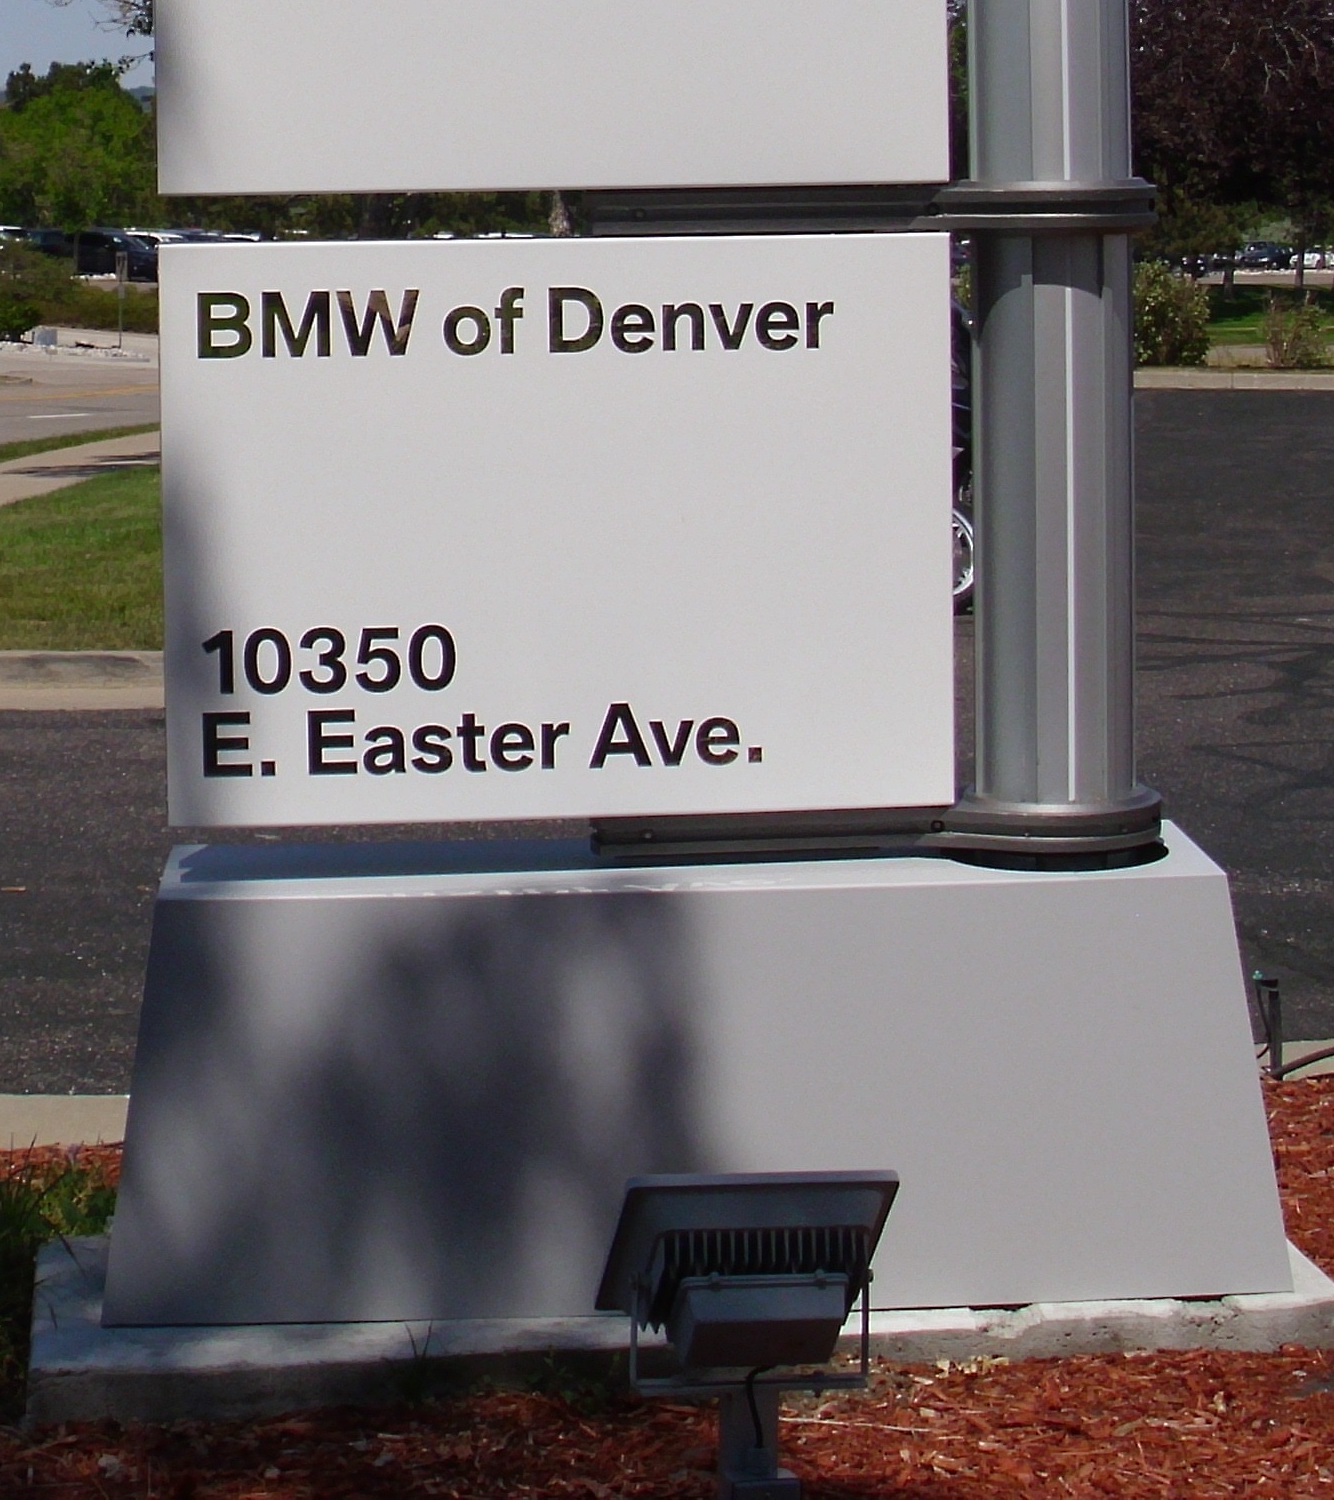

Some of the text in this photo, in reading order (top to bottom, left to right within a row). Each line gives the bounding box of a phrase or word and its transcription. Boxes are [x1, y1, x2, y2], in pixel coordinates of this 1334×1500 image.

[196, 287, 835, 359] BMW of Denver
[201, 624, 457, 695] 10350
[202, 703, 763, 778] E. Easter Ave.
